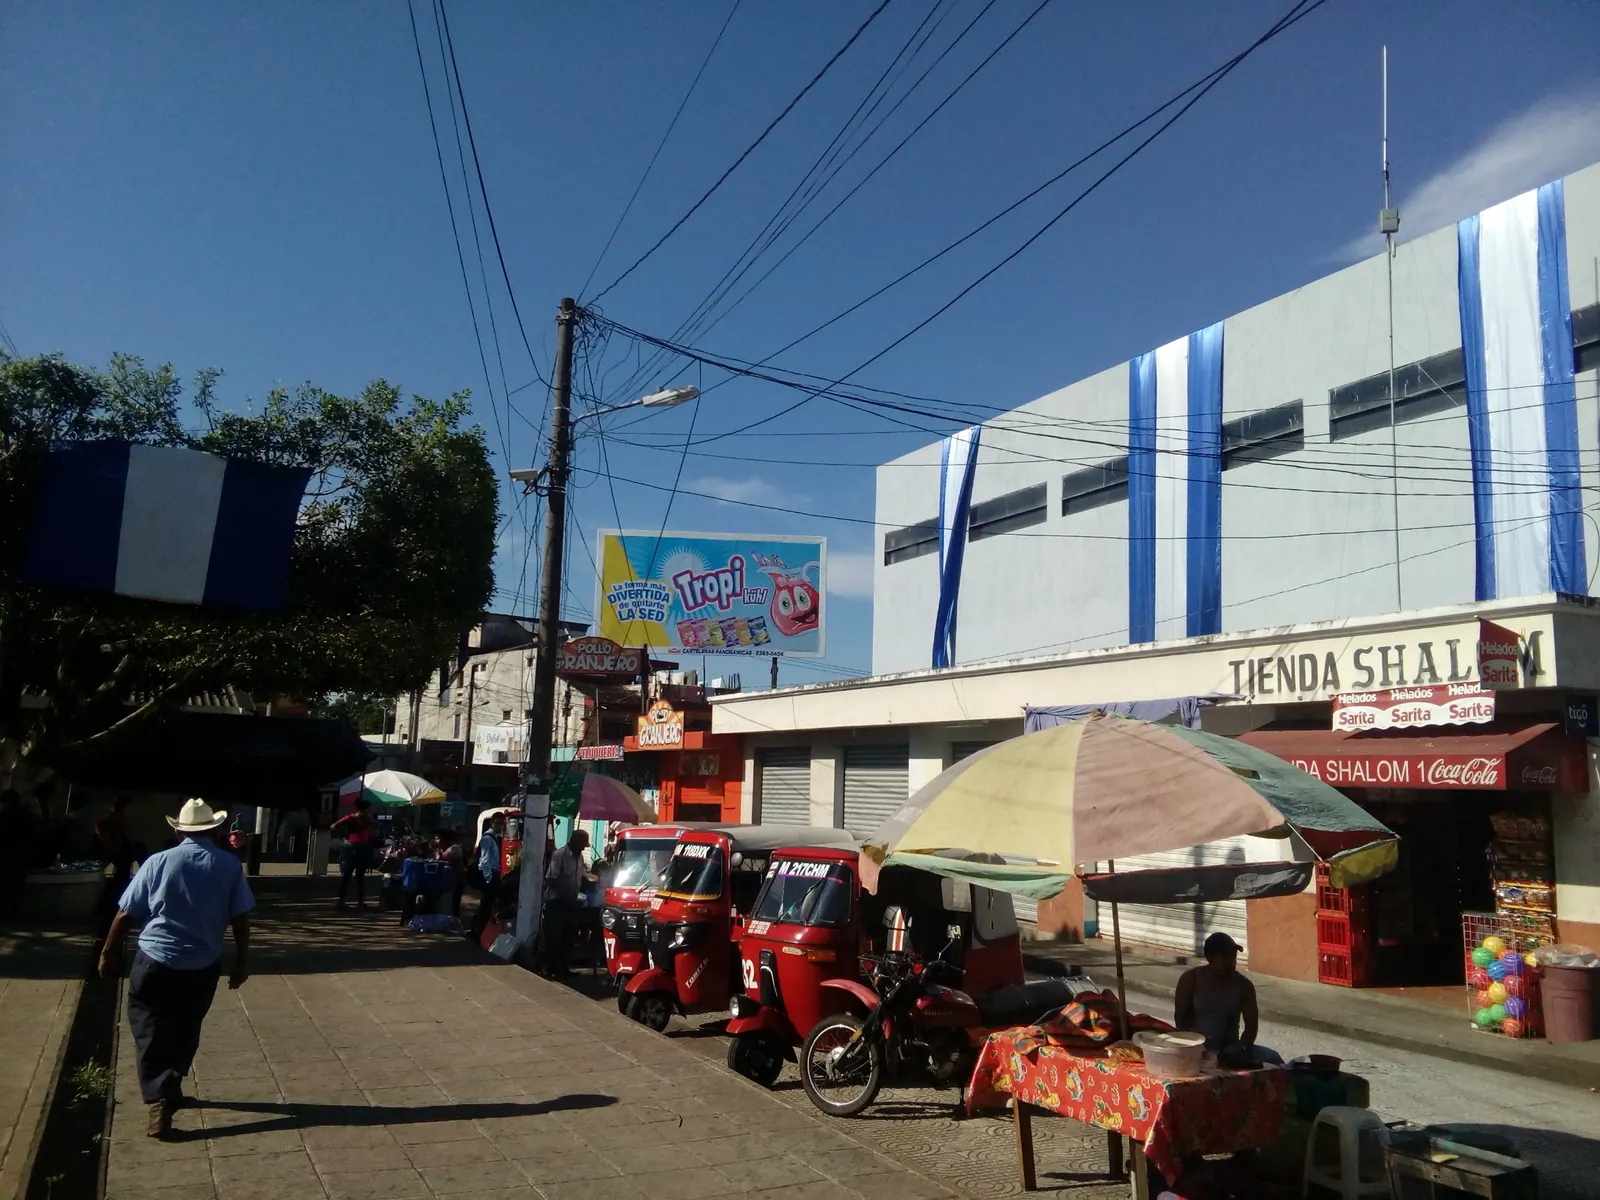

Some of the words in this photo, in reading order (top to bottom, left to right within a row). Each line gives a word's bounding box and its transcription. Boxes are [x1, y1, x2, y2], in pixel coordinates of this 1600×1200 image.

[650, 582, 667, 591] más
[673, 556, 743, 609] Tropi
[607, 589, 670, 604] DIVERTIDA
[743, 588, 768, 604] kühl
[632, 599, 665, 610] quitarte
[618, 608, 635, 621] LA
[638, 608, 665, 622] SED
[578, 643, 612, 654] POLLO
[1480, 641, 1517, 655] Helados
[1228, 651, 1340, 695] TIENDA
[1352, 630, 1546, 688] SHALM
[1482, 665, 1518, 683] Sarita
[1338, 692, 1377, 704] Helados
[1391, 688, 1433, 701] Helados
[1447, 683, 1492, 696] Helad
[1339, 711, 1375, 725] Sarita
[1391, 708, 1431, 723] Sarita
[1449, 702, 1494, 719] Sarita
[639, 723, 682, 746] GRANJERO
[578, 745, 619, 760] PELUQUERIA
[1326, 759, 1410, 783] SHALOM
[1417, 760, 1425, 782] 1
[1427, 758, 1502, 785] Coca-Cola
[778, 861, 791, 874] M
[789, 862, 830, 877] 217CHM
